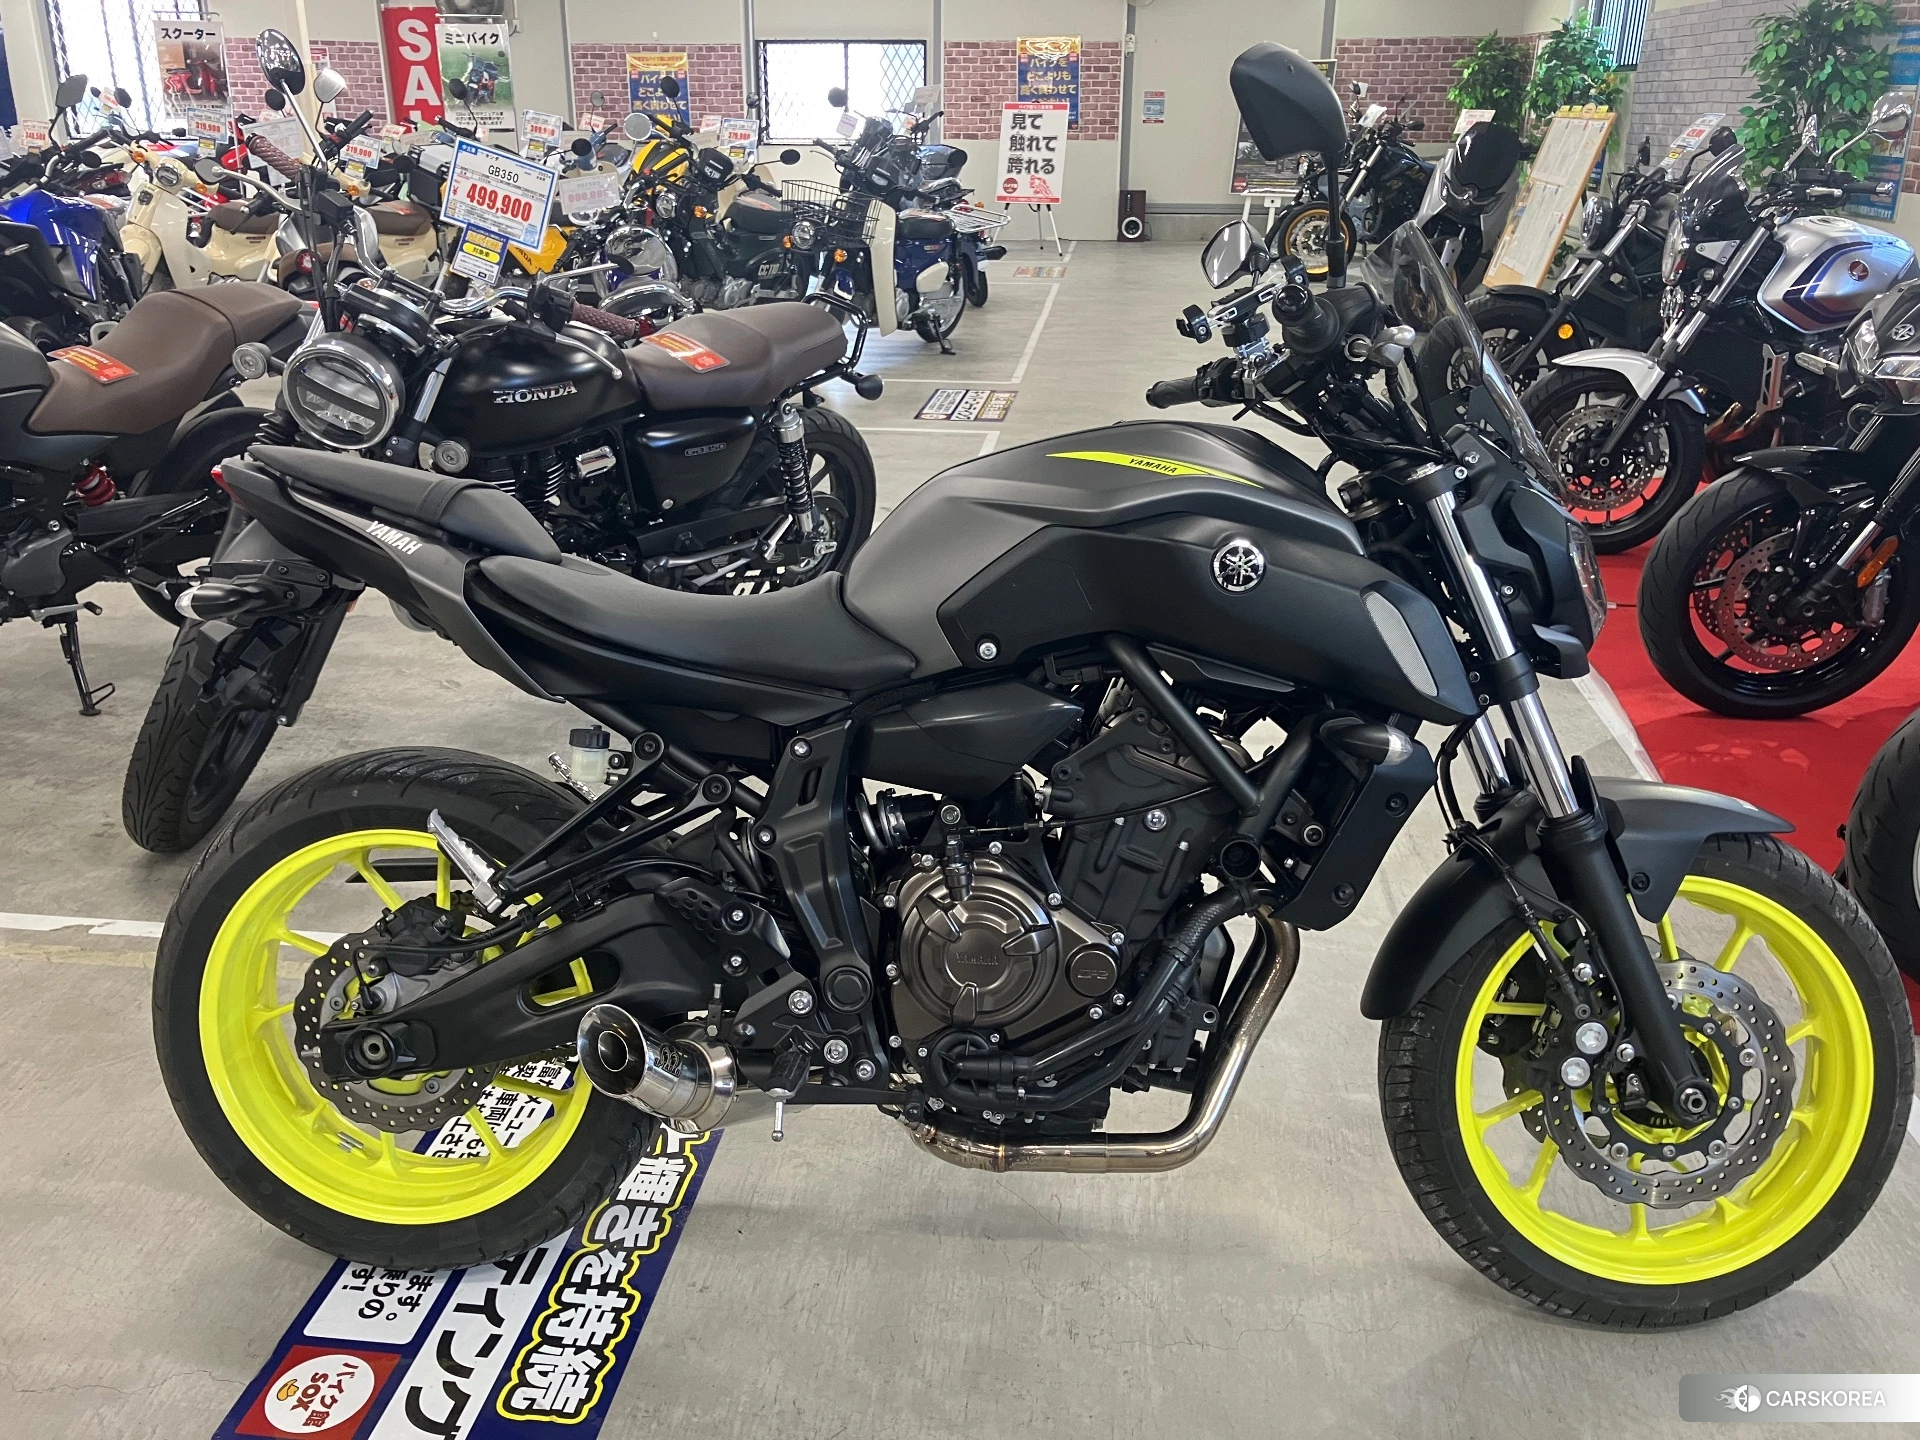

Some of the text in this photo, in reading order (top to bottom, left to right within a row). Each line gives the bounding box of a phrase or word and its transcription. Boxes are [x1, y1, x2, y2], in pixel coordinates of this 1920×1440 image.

[161, 28, 216, 40] スクーター
[445, 32, 499, 45] ミニバイク
[1027, 71, 1071, 81] どこよりも
[1011, 113, 1043, 130] 見て
[1009, 135, 1058, 152] 触れて
[488, 165, 519, 183] GB350
[466, 183, 533, 223] 499,900
[493, 381, 578, 404] HONDA
[1129, 458, 1177, 474] YAMAHA
[503, 1094, 542, 1147] メニュー
[290, 1372, 328, 1411] SOX
[302, 1363, 359, 1427] バイク館
